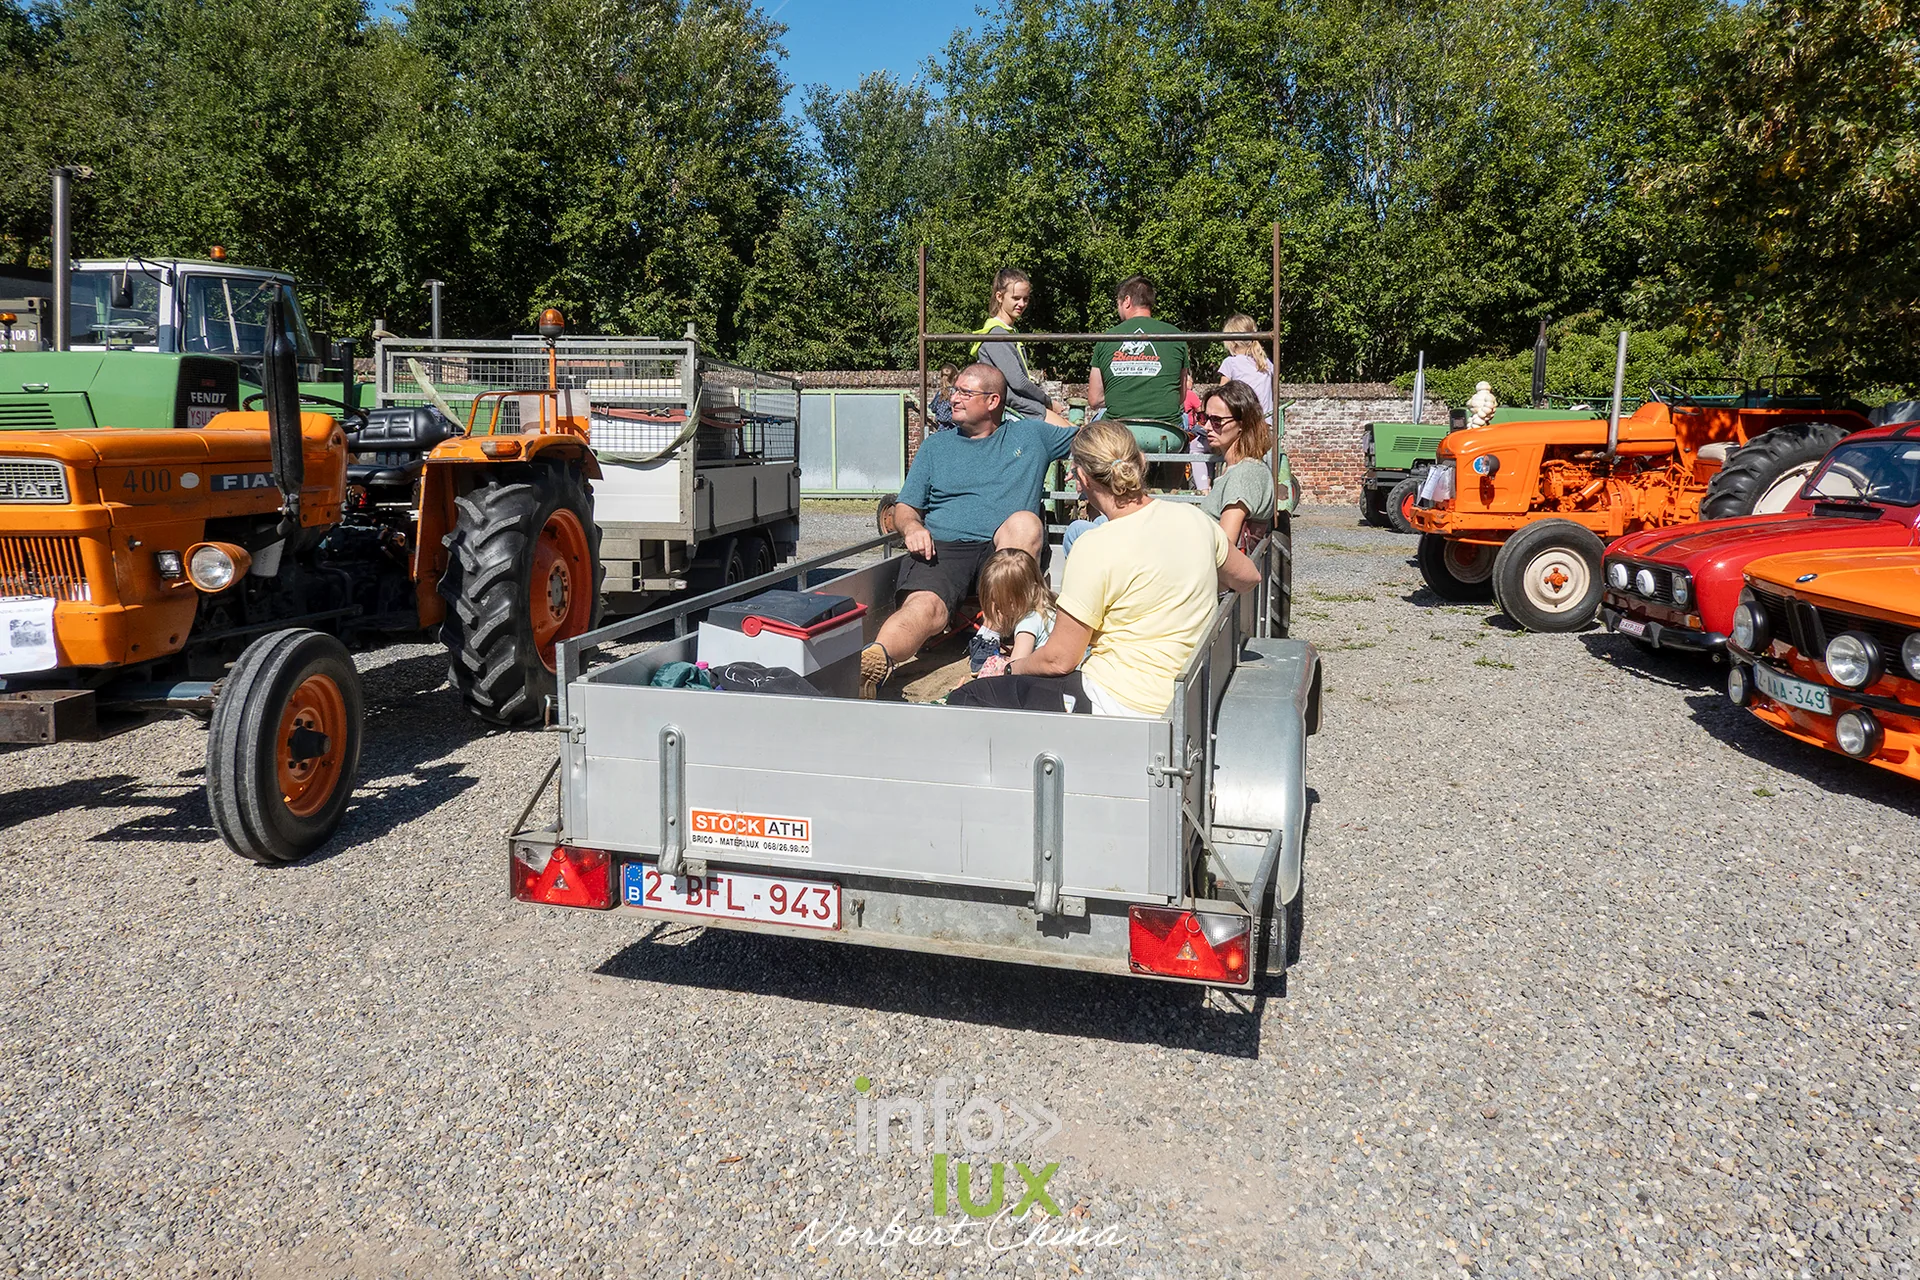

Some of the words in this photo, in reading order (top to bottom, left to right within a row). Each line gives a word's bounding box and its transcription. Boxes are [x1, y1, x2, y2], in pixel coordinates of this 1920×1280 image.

[190, 392, 227, 404] FENDT
[123, 468, 171, 493] 400
[696, 814, 761, 835] STOCK
[767, 821, 804, 837] ATH
[692, 834, 713, 845] BRICO
[628, 886, 640, 901] B
